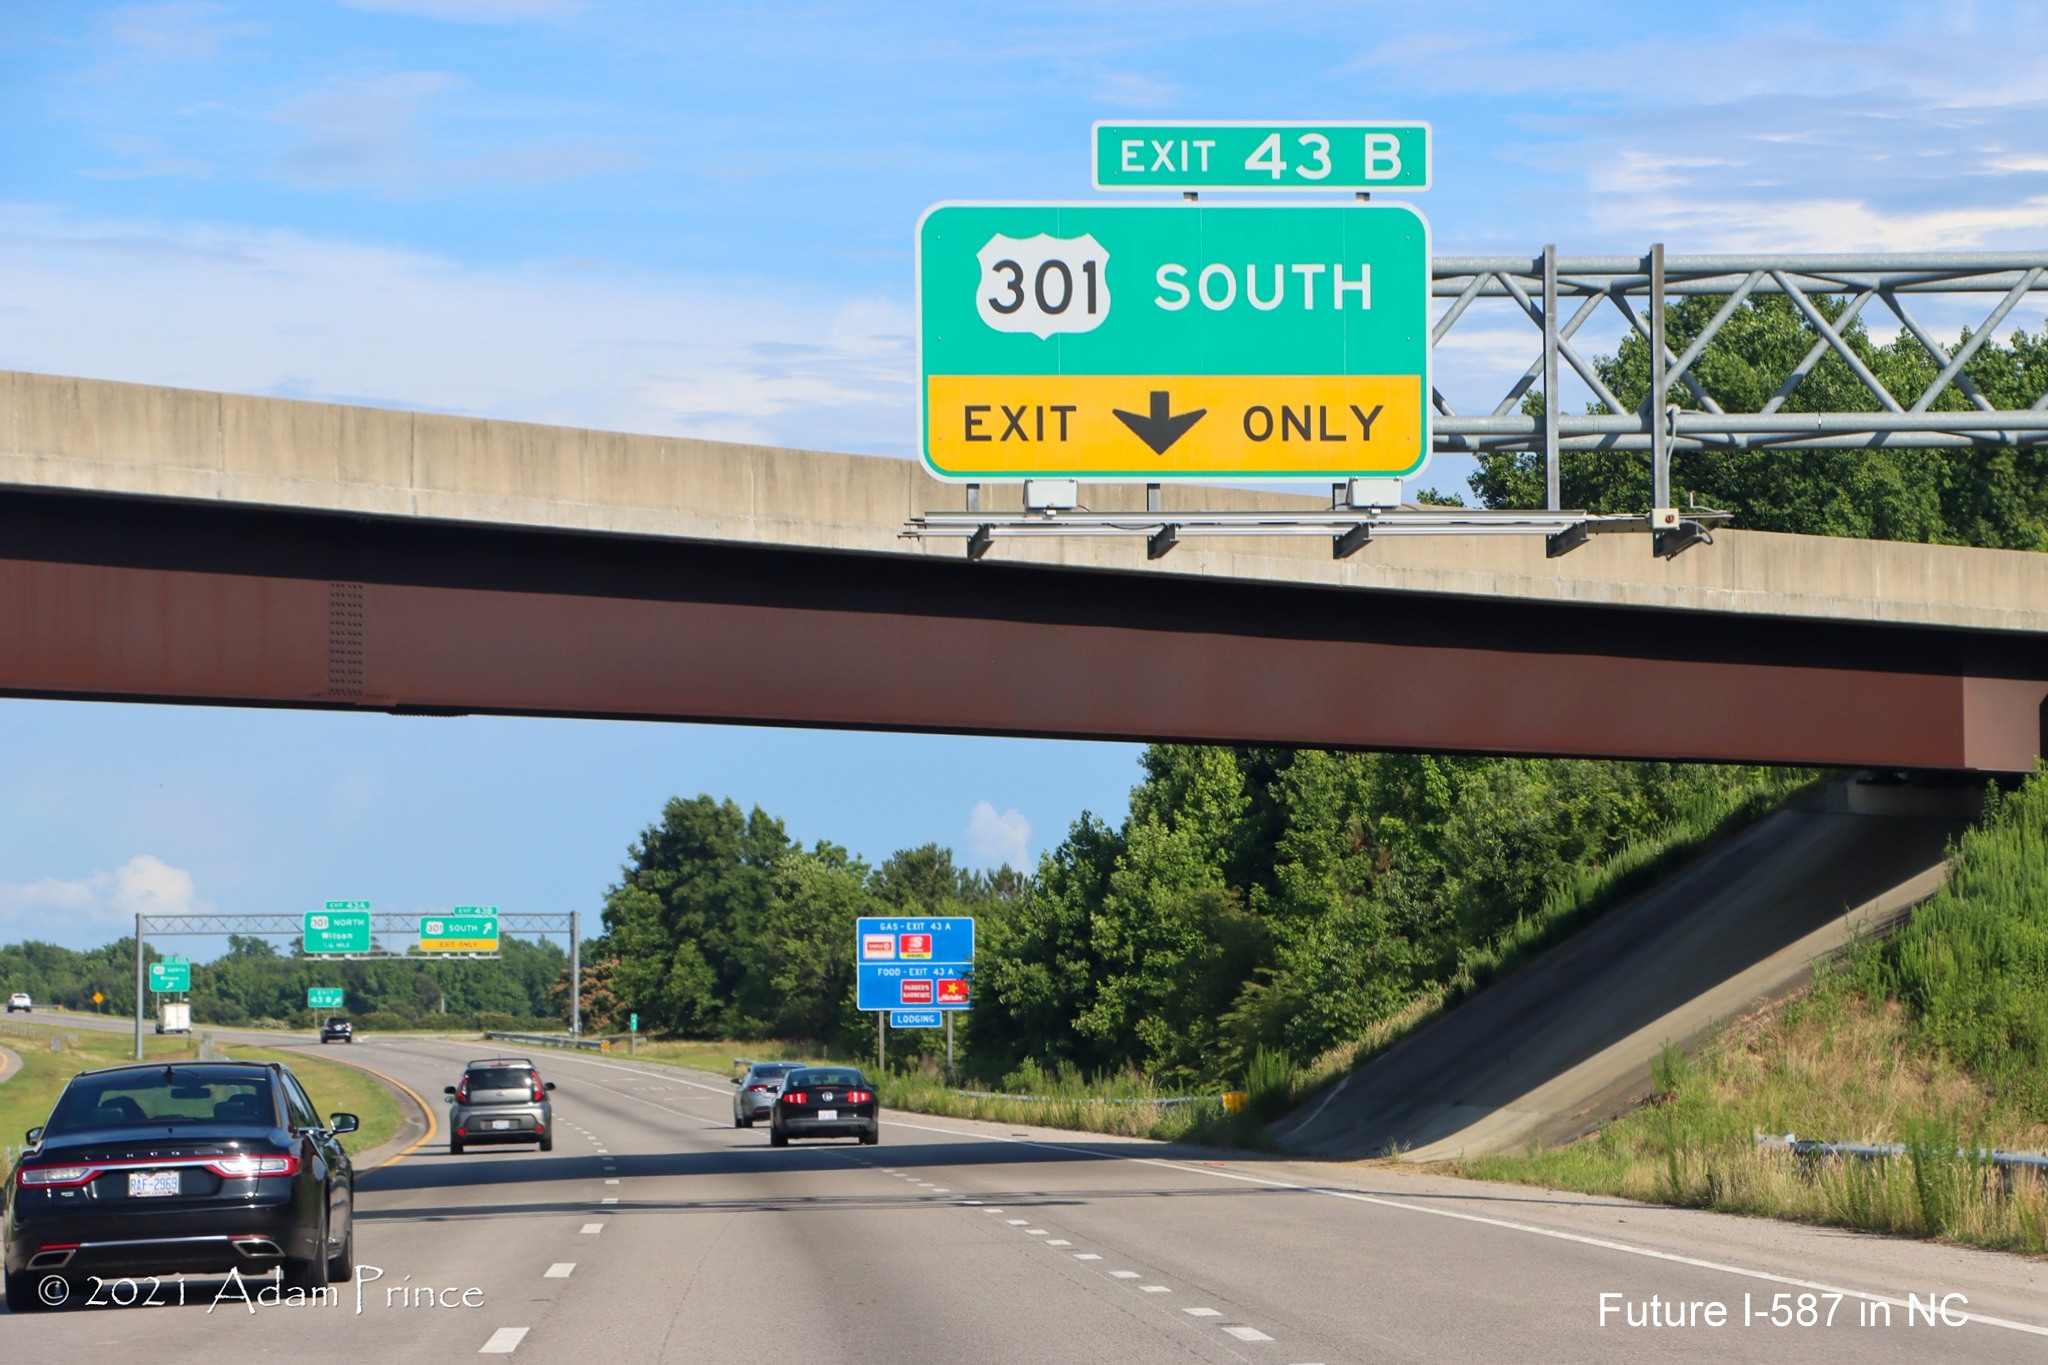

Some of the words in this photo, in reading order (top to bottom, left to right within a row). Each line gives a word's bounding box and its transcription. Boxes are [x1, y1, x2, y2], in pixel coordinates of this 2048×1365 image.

[1121, 140, 1216, 171] EXIT
[1244, 133, 1332, 180] 43
[1365, 133, 1402, 179] B
[988, 260, 1097, 315] 301
[1155, 263, 1371, 311] SOUTH
[964, 405, 1077, 441] EXIT
[1243, 405, 1383, 442] ONLY
[311, 919, 327, 927] 301
[880, 922, 898, 931] GAS
[906, 922, 925, 931] EXIT
[930, 922, 942, 930] 43
[945, 922, 951, 930] A
[427, 924, 442, 932] 301
[448, 924, 478, 932] SOUTH
[878, 968, 900, 976] FOOD
[909, 968, 928, 976] EXIT
[933, 967, 945, 976] 43
[947, 967, 954, 976] A
[897, 1015, 935, 1024] LODGING
[130, 1176, 178, 1192] RAF-2969
